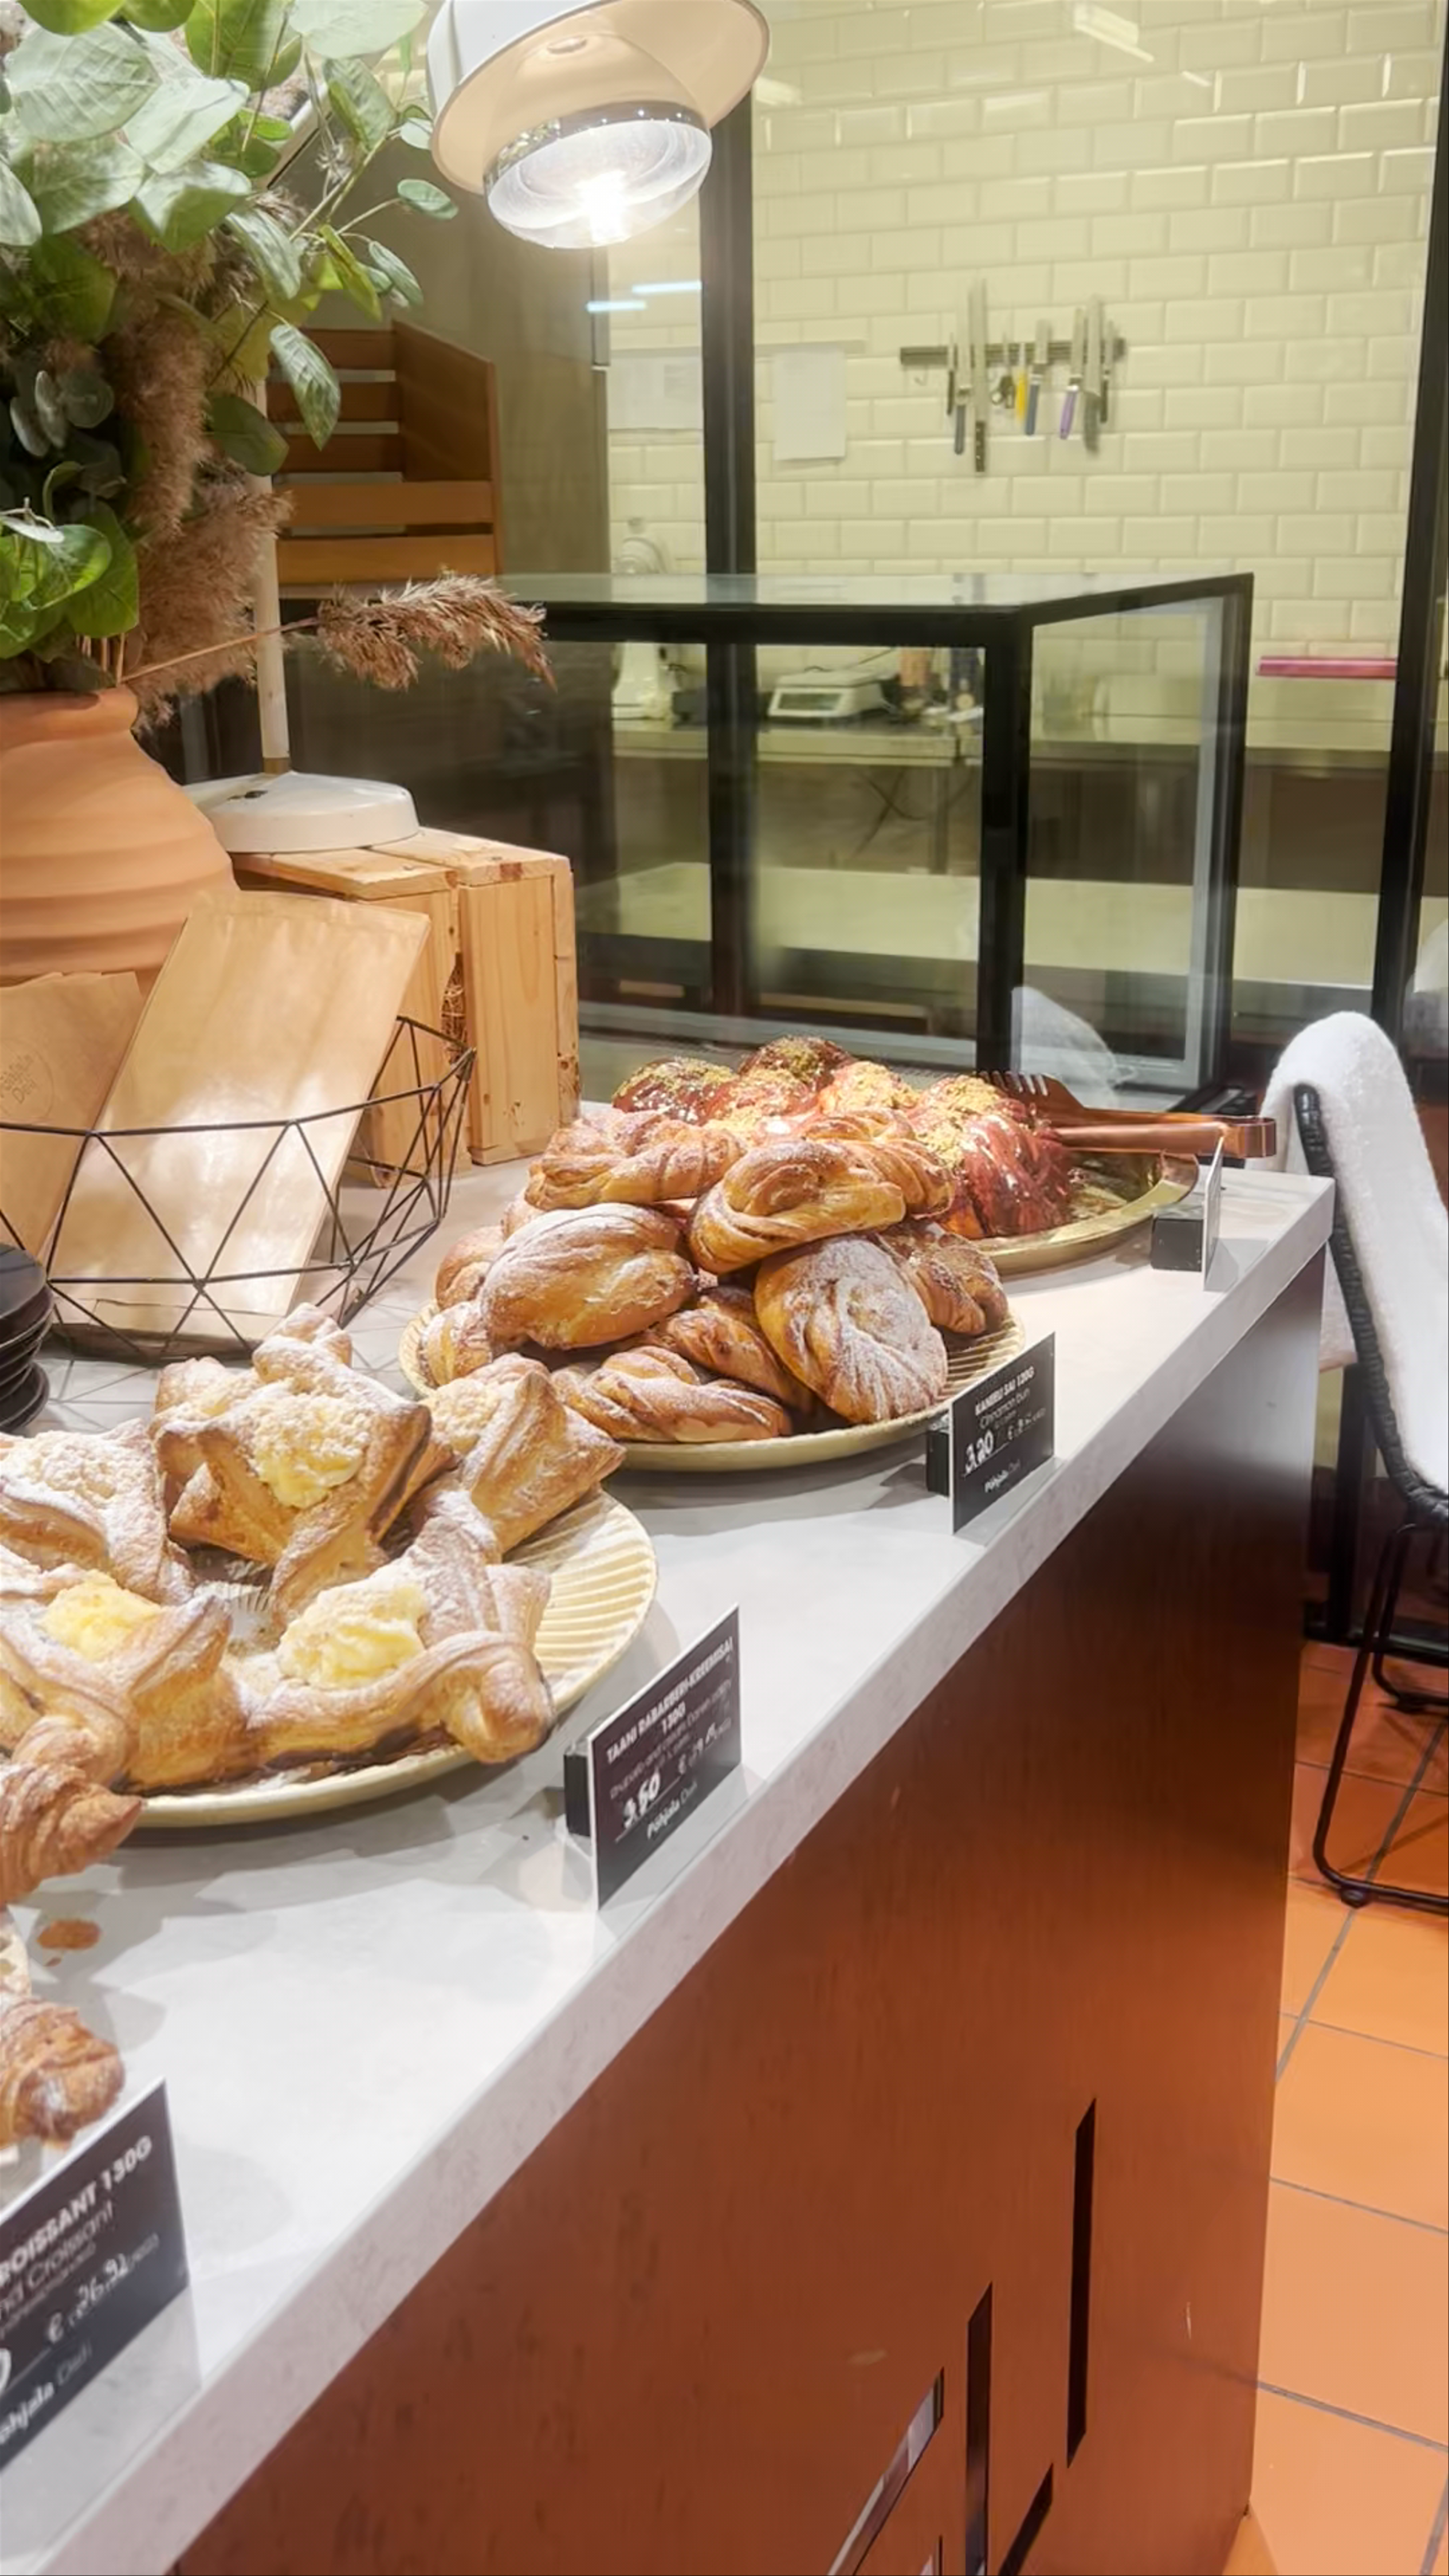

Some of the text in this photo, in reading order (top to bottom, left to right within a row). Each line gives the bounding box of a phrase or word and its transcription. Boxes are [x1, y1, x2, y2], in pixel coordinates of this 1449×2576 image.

[606, 1726, 638, 1764] TAANI
[101, 2135, 152, 2190] 130G
[27, 2199, 113, 2290] Croissant
